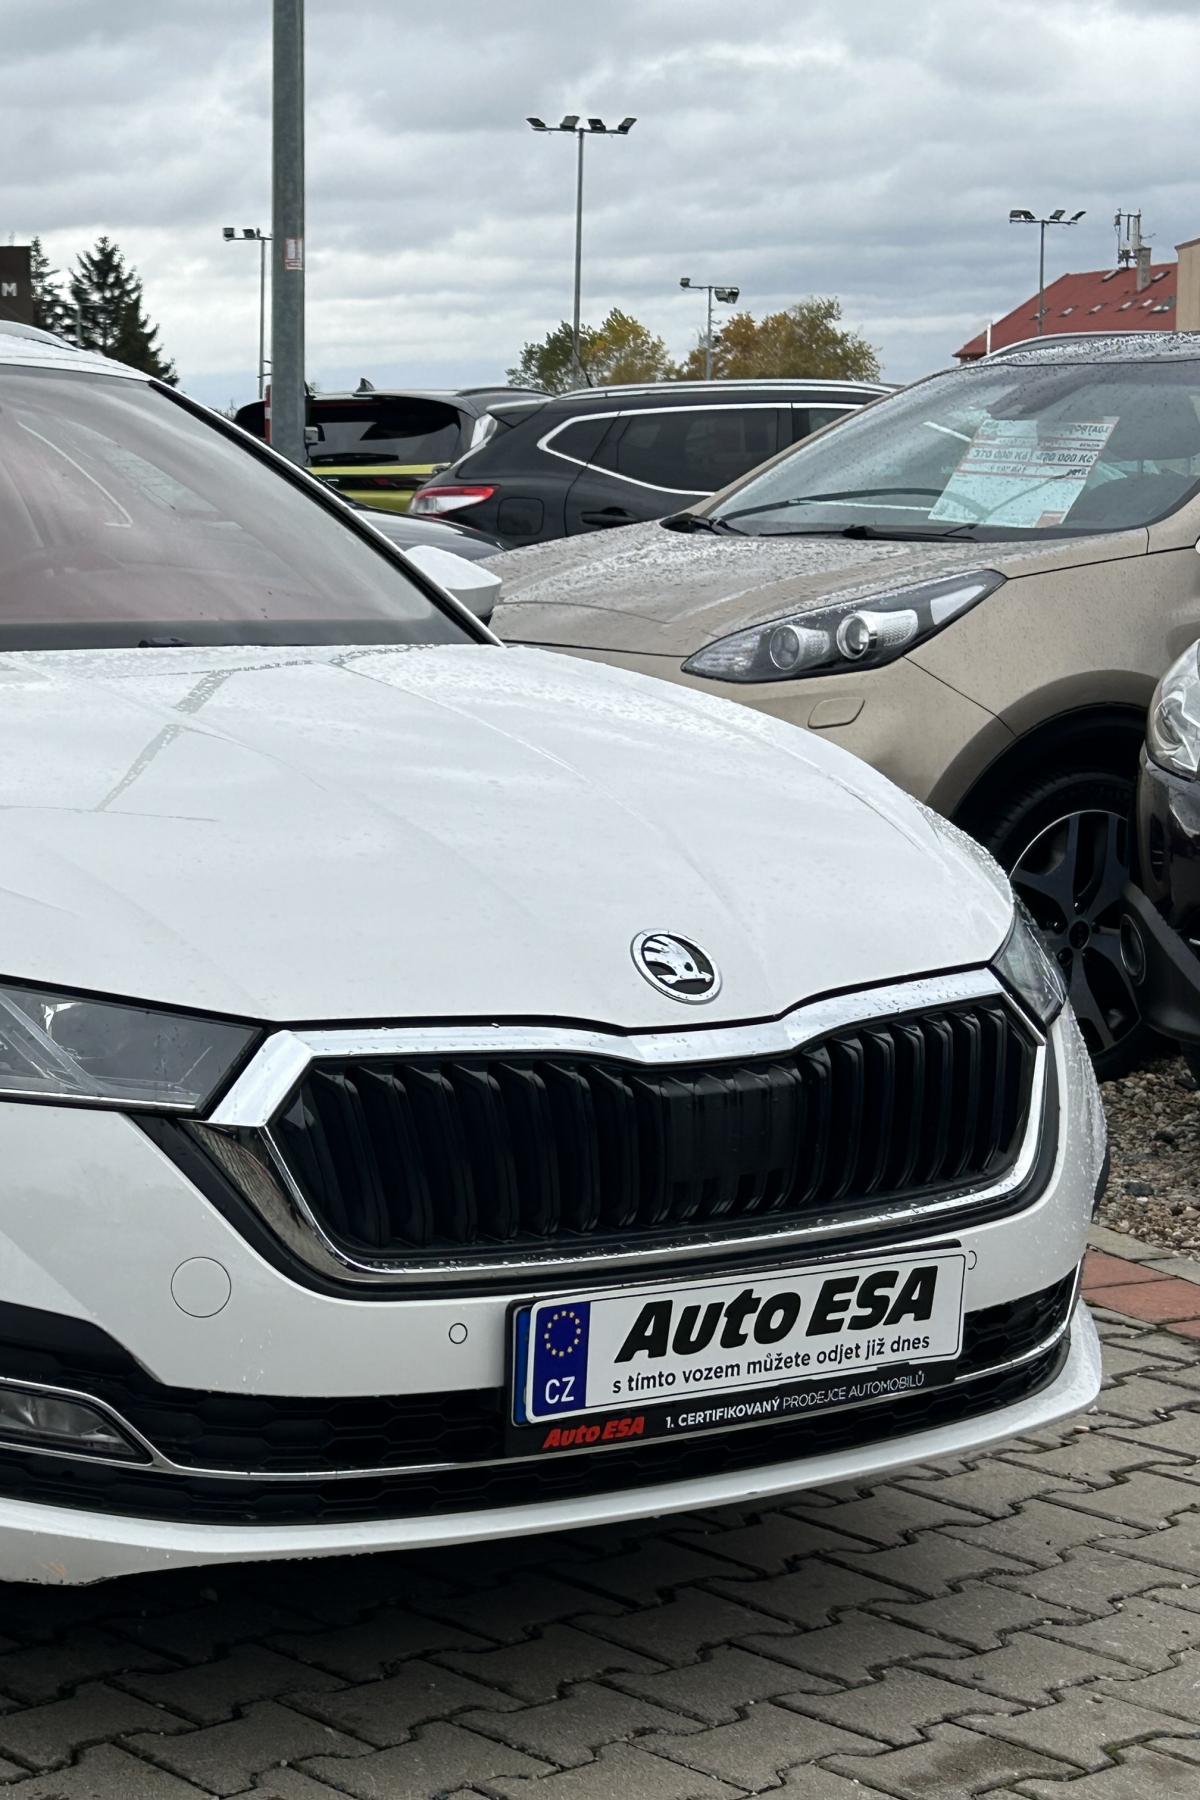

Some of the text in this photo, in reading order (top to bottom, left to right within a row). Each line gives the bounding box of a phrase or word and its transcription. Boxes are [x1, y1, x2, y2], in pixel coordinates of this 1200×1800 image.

[614, 1265, 938, 1364] Auto ESA
[545, 1376, 576, 1404] CZ
[612, 1334, 930, 1394] s tímto vozem můžete odjet již dnes
[666, 1371, 925, 1428] 1. CERTIFIKOVANÝ PRODEJCE AUTOMOBILŮ
[543, 1415, 645, 1448] Auto ESA
